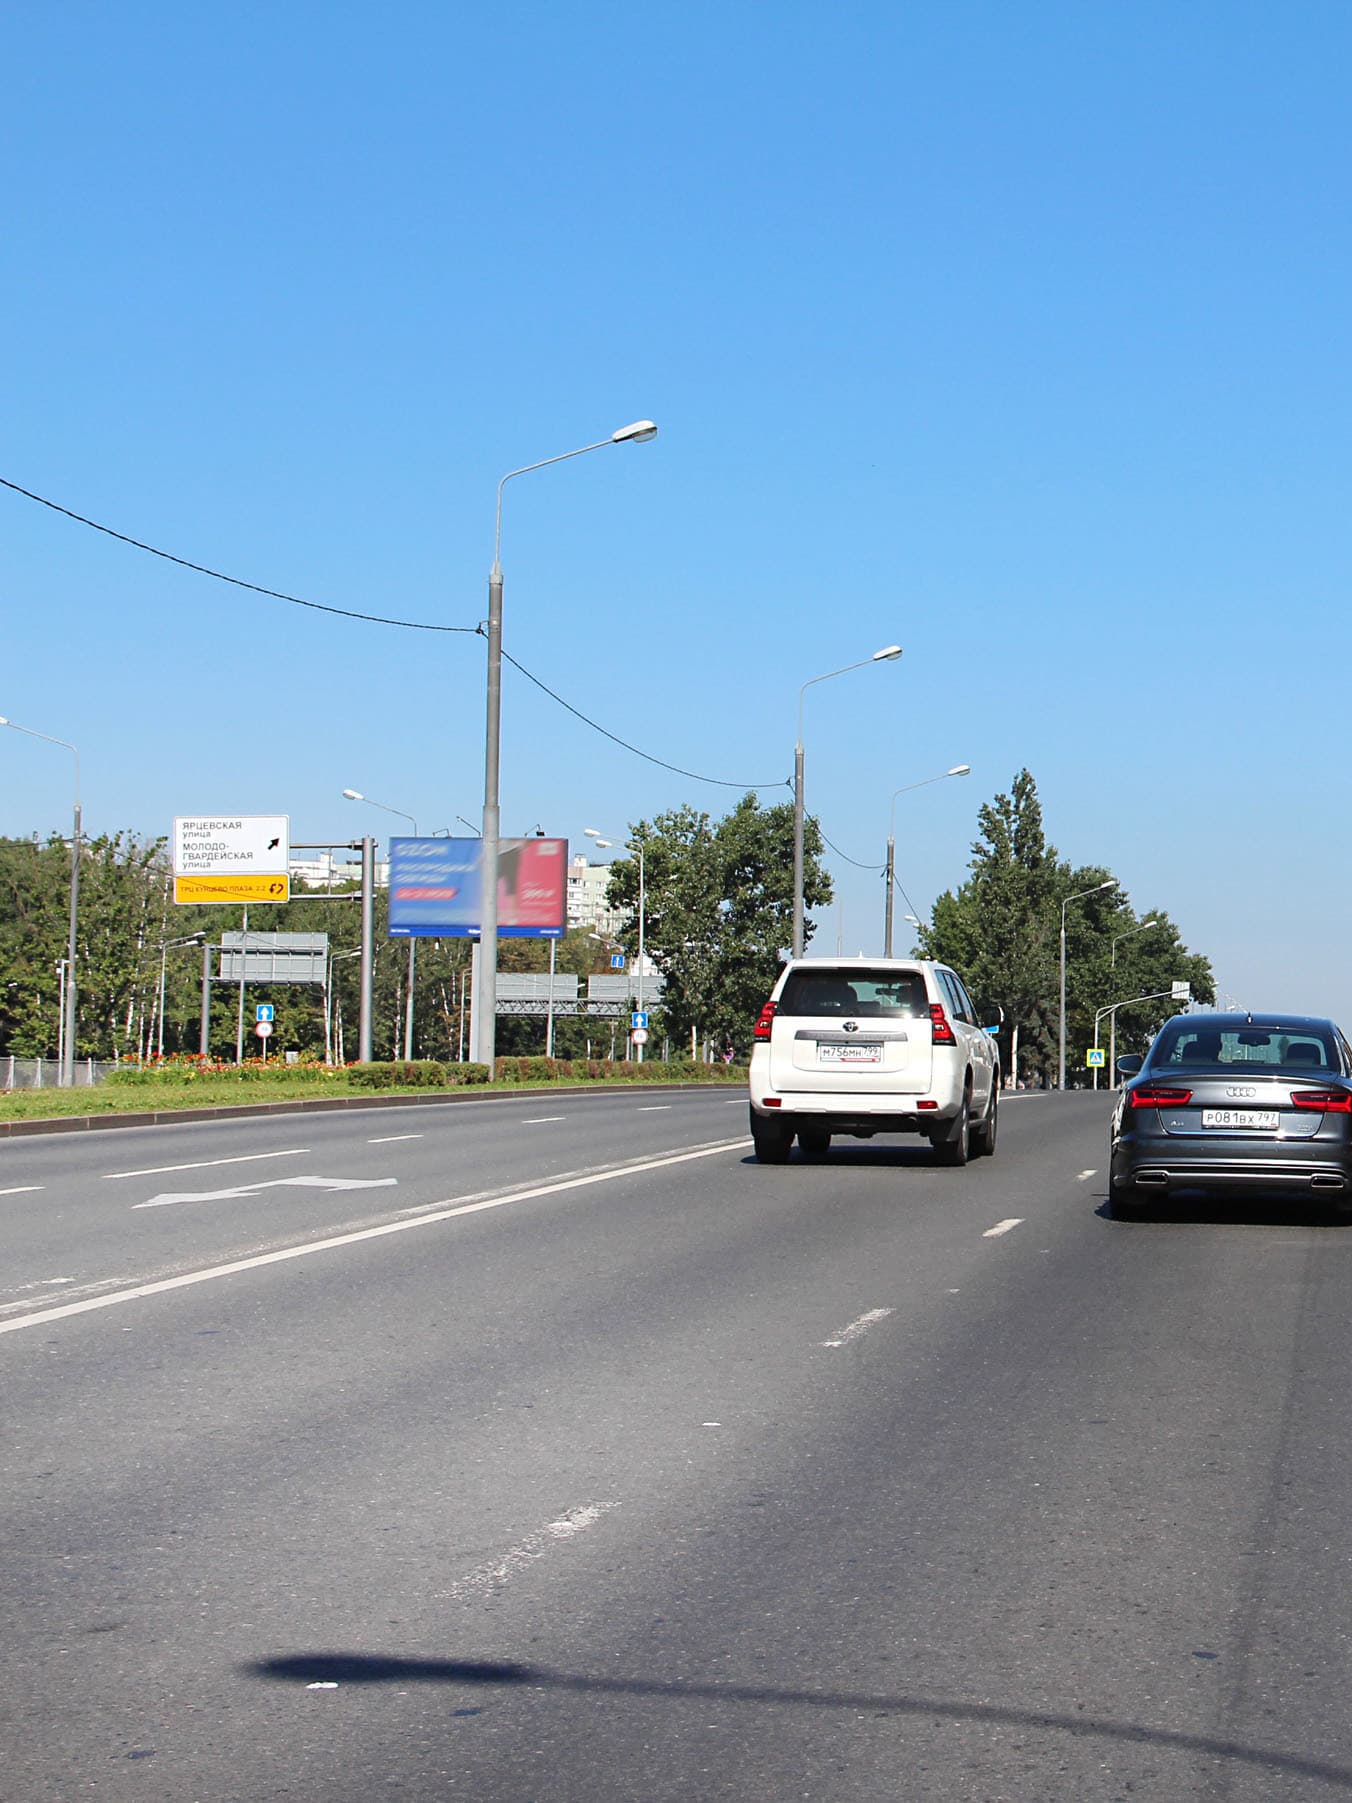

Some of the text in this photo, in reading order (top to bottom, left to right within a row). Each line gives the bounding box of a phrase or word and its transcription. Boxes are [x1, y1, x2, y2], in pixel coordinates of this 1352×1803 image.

[182, 821, 242, 831] ЯРЦЕВСКАЯ
[182, 831, 211, 840] улица
[182, 842, 230, 851] МОЛОДО-
[182, 851, 254, 861] ГВАРДЕЙСКАЯ
[182, 861, 211, 870] улица
